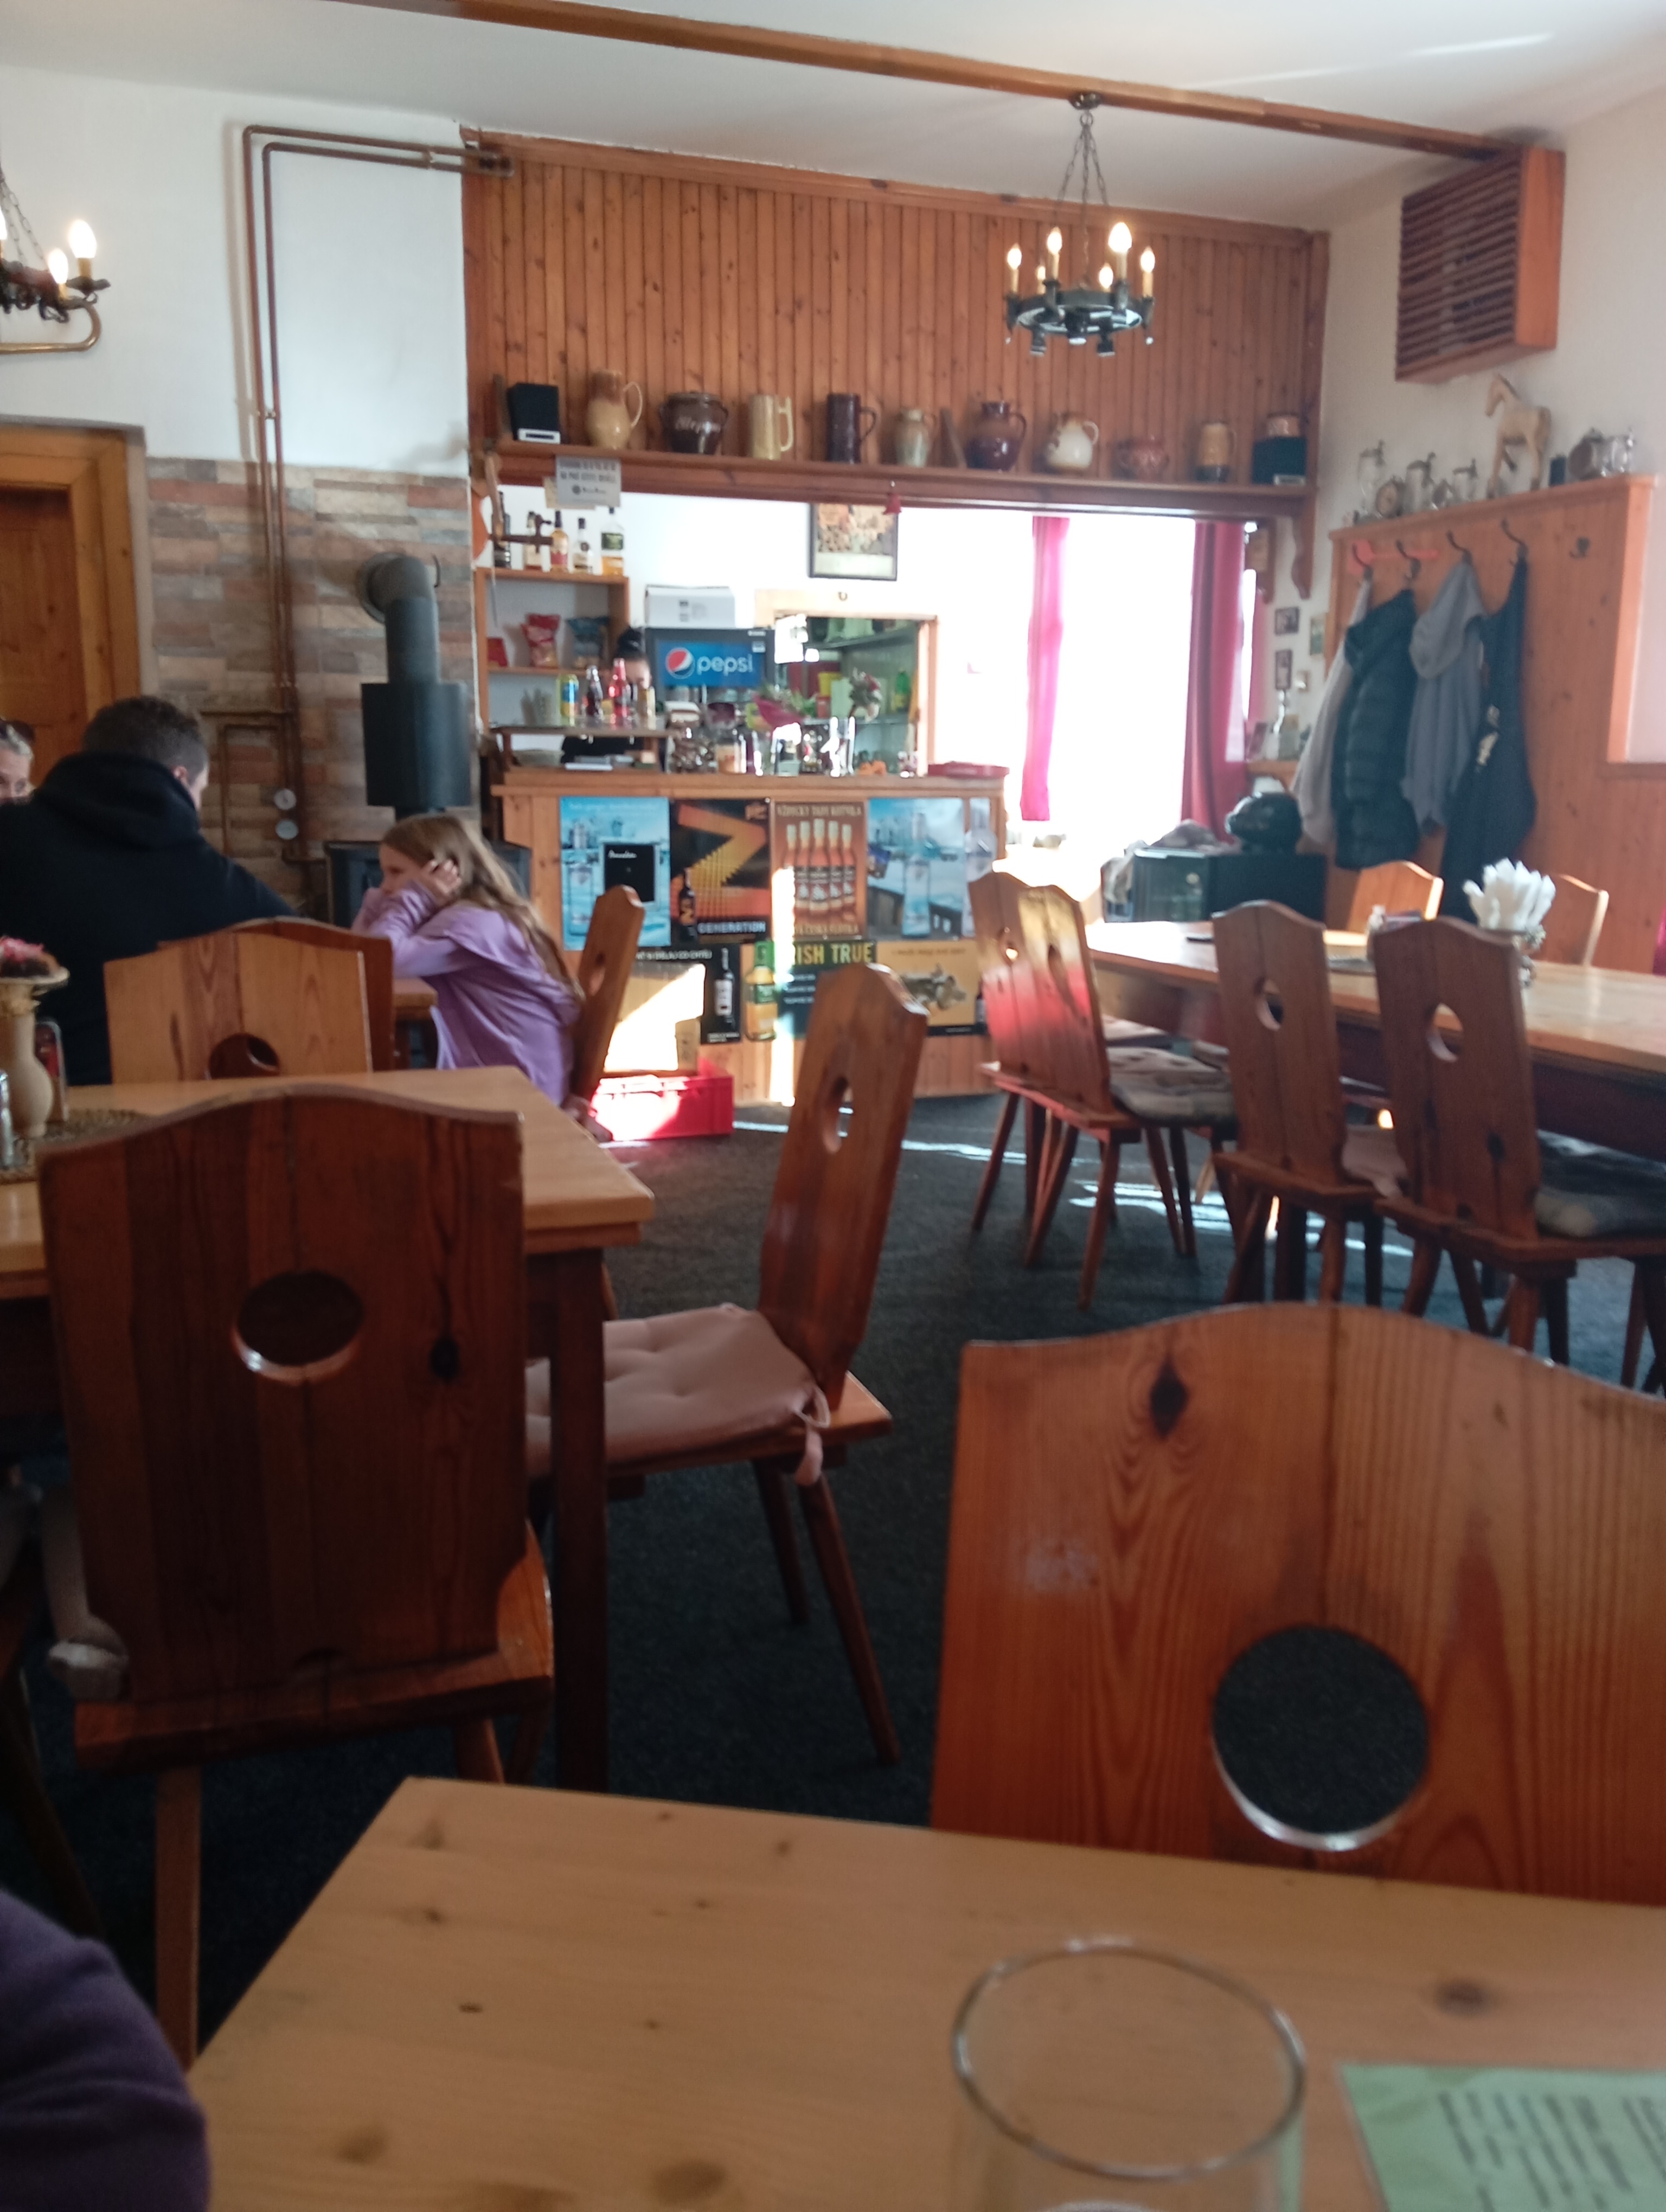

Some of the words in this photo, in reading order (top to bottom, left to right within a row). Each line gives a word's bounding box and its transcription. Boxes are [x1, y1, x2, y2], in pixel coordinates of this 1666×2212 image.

[697, 654, 753, 677] pepsi
[794, 944, 824, 966] ISH
[830, 943, 873, 964] TRUE
